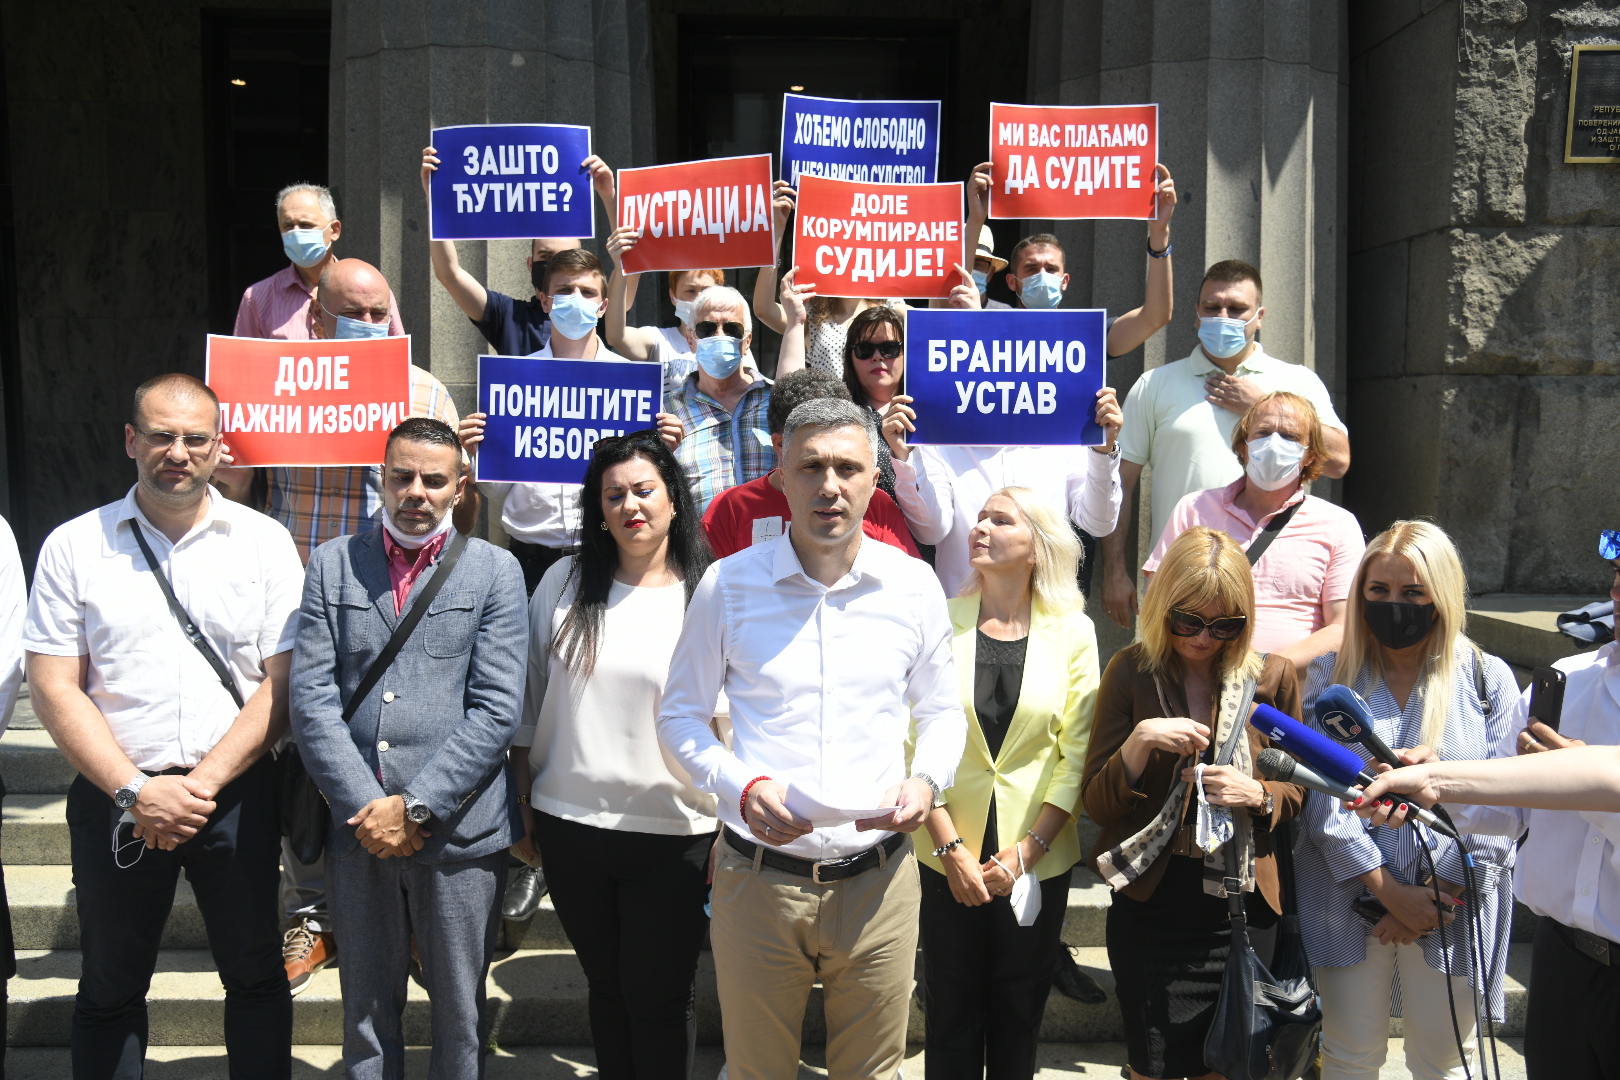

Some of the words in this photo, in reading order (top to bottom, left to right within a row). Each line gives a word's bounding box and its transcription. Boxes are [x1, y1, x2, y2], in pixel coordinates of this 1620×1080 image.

[793, 112, 851, 148] ХОЋЕМО
[853, 117, 926, 155] СЛОБОДНО
[999, 122, 1024, 147] МИ
[1028, 124, 1061, 148] ВАС
[1064, 123, 1149, 148] ПЛАЋАМО
[463, 145, 559, 175] ЗАШТО
[790, 159, 800, 186] И
[1005, 154, 1040, 195] ДА
[1045, 155, 1141, 196] СУДИТЕ
[452, 182, 573, 214] ЋУТИТЕ?
[850, 192, 908, 217] ДОЛЕ
[802, 215, 959, 242] КОРУМПИРАНЕ
[815, 245, 945, 282] СУДИЈЕ!
[928, 339, 1086, 373] БРАНИМО
[274, 356, 350, 396] ДОЛЕ
[489, 383, 652, 422] ПОНИШТИТЕ
[954, 380, 1057, 415] УСТАВ
[514, 425, 625, 461] ИЗБОР
